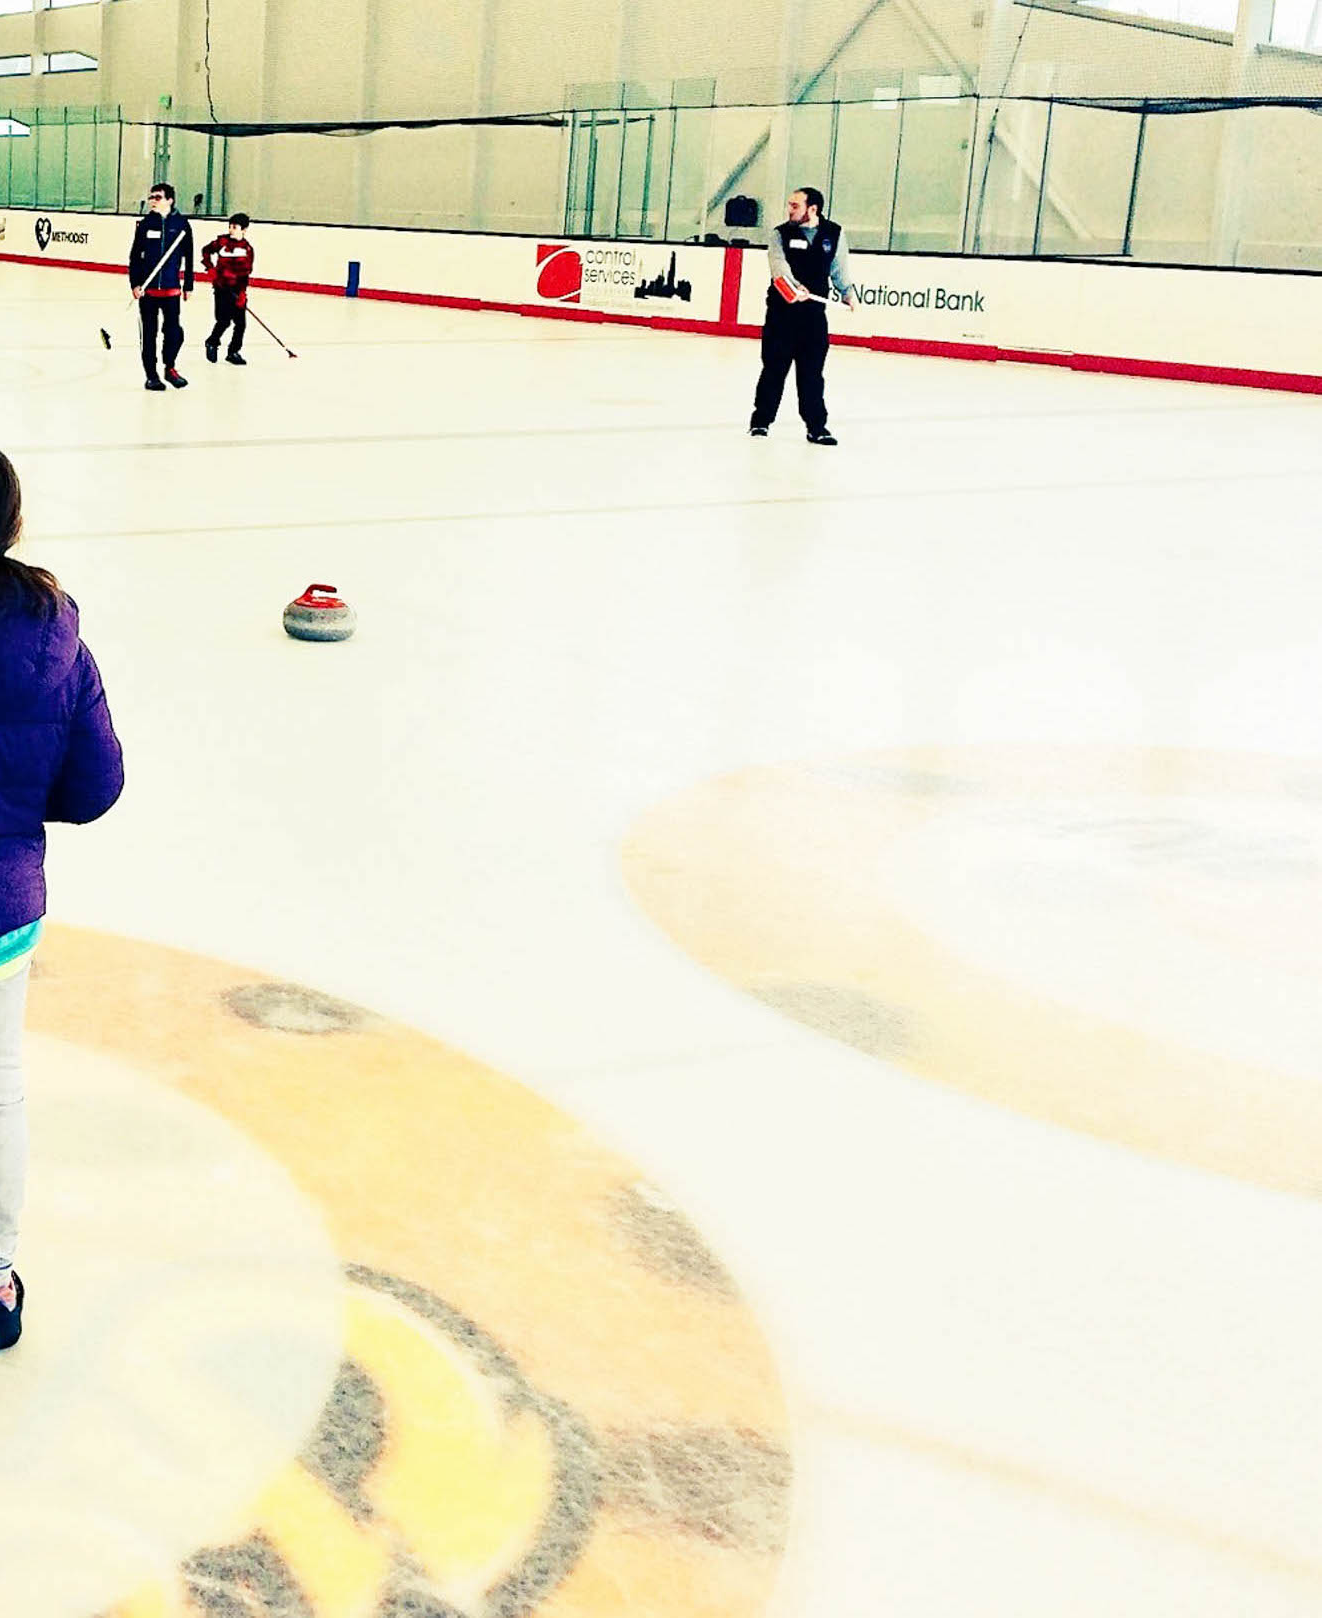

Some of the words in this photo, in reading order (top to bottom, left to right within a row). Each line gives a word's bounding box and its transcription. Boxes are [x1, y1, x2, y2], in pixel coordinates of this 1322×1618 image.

[51, 231, 89, 244] METHODIST
[585, 249, 636, 267] control
[584, 268, 636, 286] services
[934, 288, 985, 313] Bank
